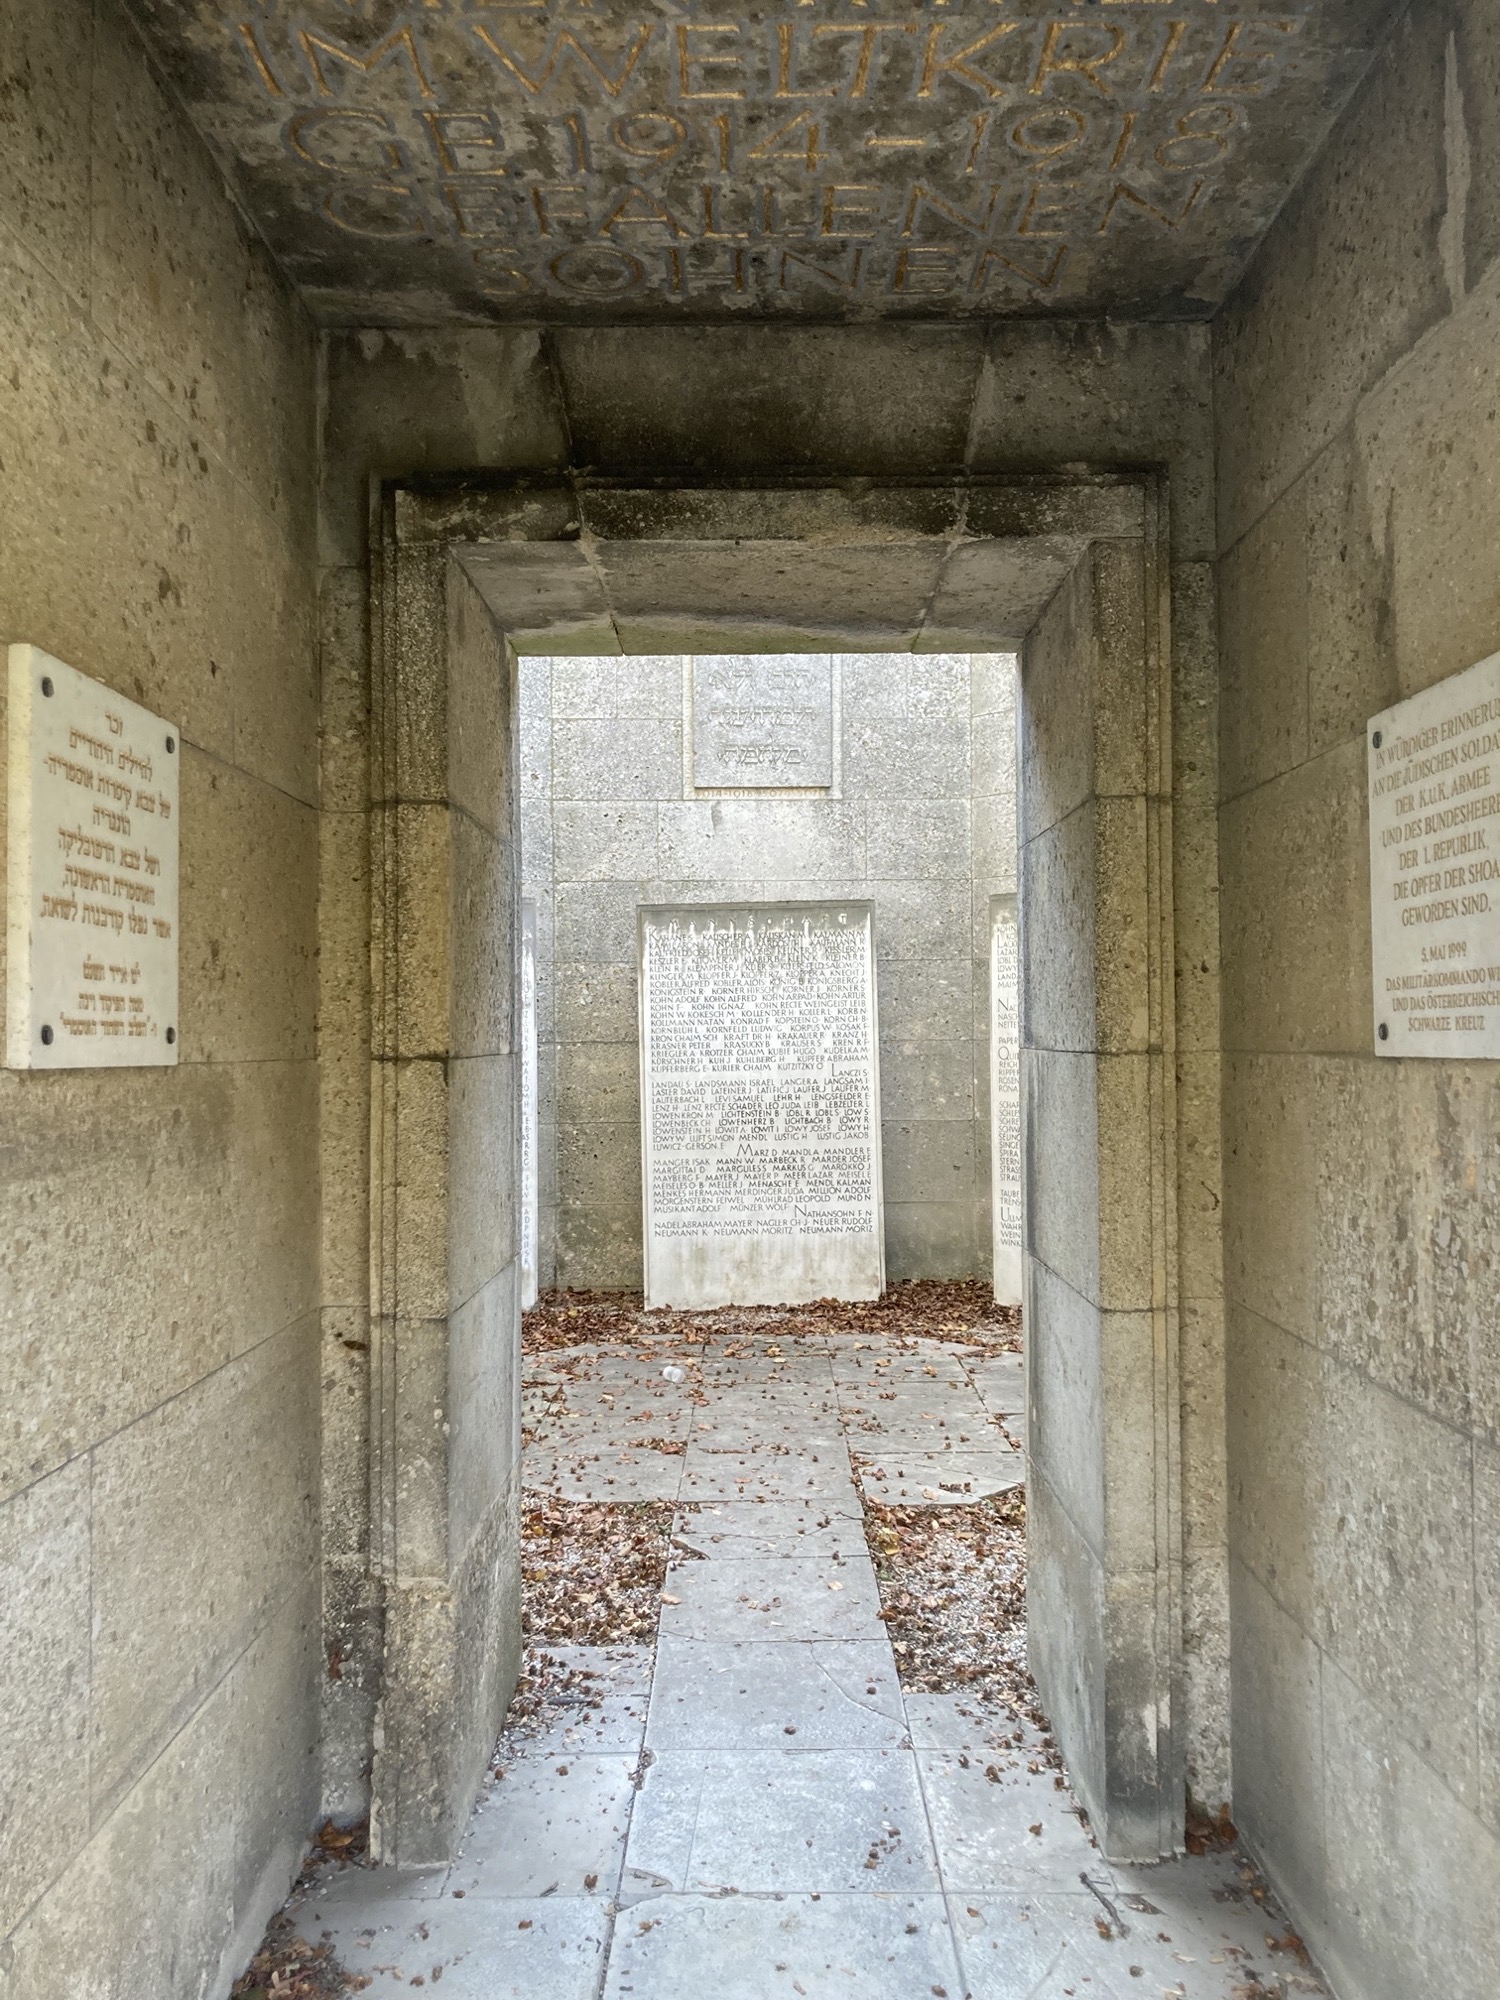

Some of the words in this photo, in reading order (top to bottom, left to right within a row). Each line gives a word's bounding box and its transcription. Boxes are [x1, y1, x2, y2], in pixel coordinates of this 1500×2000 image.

[240, 23, 435, 99] IM
[473, 20, 1299, 99] WELTKRIE
[324, 180, 1203, 238] GEFALLENEN
[1387, 771, 1402, 792] DIE
[1395, 795, 1415, 816] DER
[1451, 766, 1491, 797] ARMEE
[1382, 827, 1402, 847] UND
[1404, 819, 1423, 841] DES
[1399, 850, 1418, 870] DER
[1393, 880, 1409, 901] DIE
[1411, 873, 1441, 898] OPFER
[1444, 867, 1466, 889] DER
[1402, 899, 1459, 927] GEWORDEN
[1461, 893, 1491, 916] SIND.
[1430, 945, 1446, 961] MAI
[1448, 941, 1467, 958] 1999
[1386, 977, 1401, 991] DAS
[1392, 997, 1408, 1012] UND
[1410, 995, 1426, 1011] DAS
[1408, 1017, 1451, 1032] SCHWARZE
[1455, 1016, 1485, 1031] KREUZ
[827, 1054, 868, 1062] ABRAHAM
[796, 1195, 831, 1203] LEOPOLD
